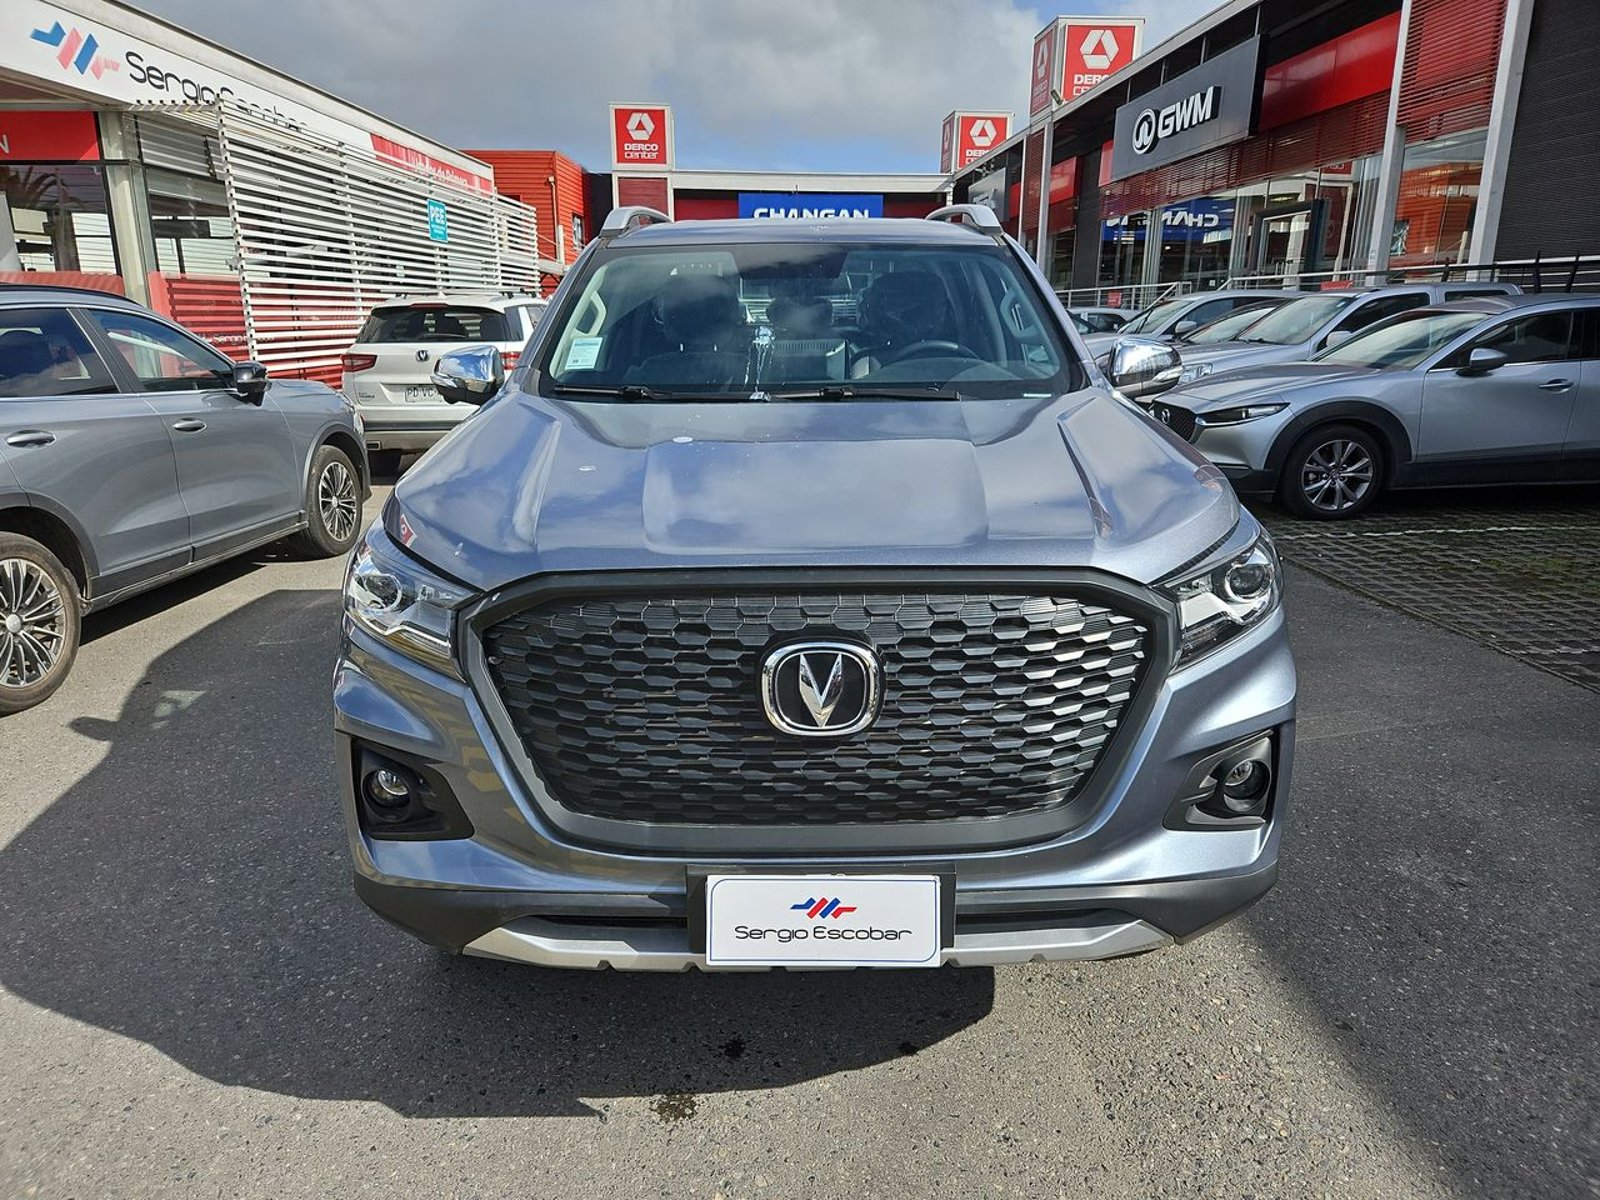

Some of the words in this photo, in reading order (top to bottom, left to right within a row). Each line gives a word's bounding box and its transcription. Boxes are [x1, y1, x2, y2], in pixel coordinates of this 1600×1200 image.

[1158, 86, 1215, 139] GWM
[624, 143, 659, 152] DERCO
[624, 151, 659, 160] center
[753, 208, 870, 219] CHANGAN
[734, 925, 808, 943] Sergio
[813, 925, 912, 941] Escobar
